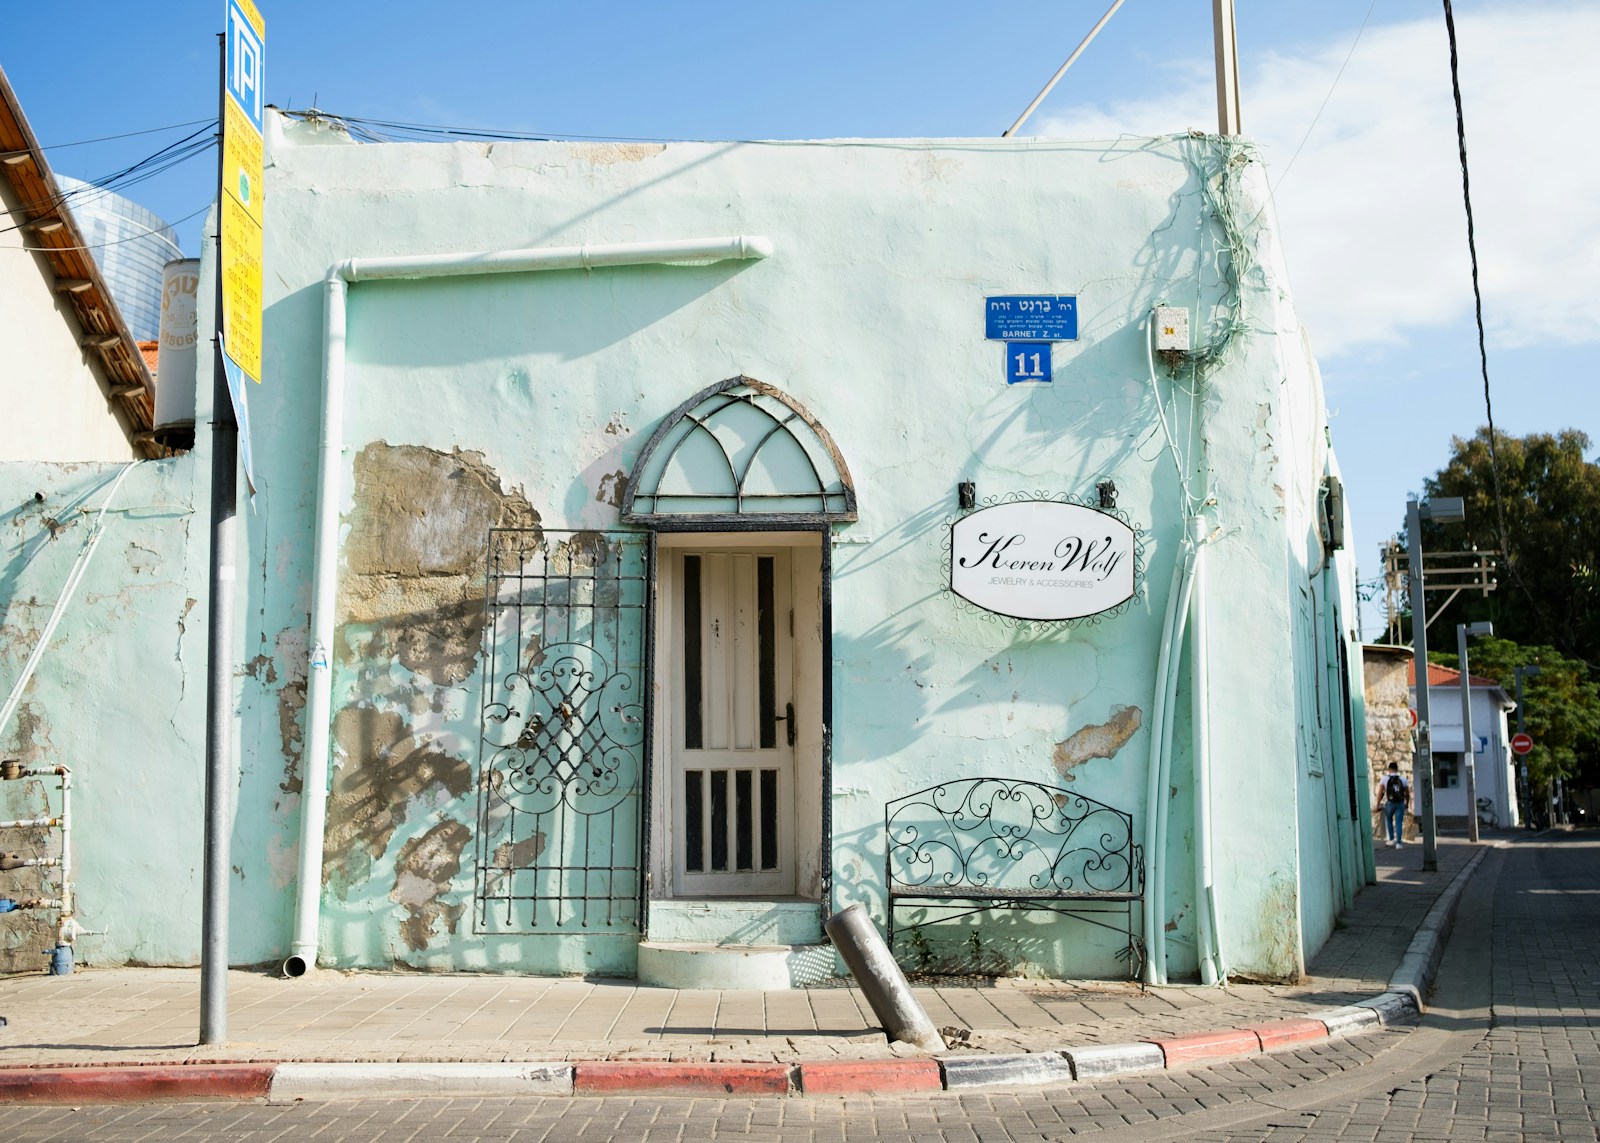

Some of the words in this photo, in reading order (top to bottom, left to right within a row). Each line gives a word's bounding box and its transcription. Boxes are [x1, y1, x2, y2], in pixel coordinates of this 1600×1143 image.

[1015, 352, 1044, 377] 11
[959, 532, 1055, 571] Keren
[1054, 536, 1127, 582] Wolf
[988, 577, 1028, 586] JEWELRY
[1029, 578, 1035, 586] &
[1036, 579, 1094, 589] ACCESSORIES
